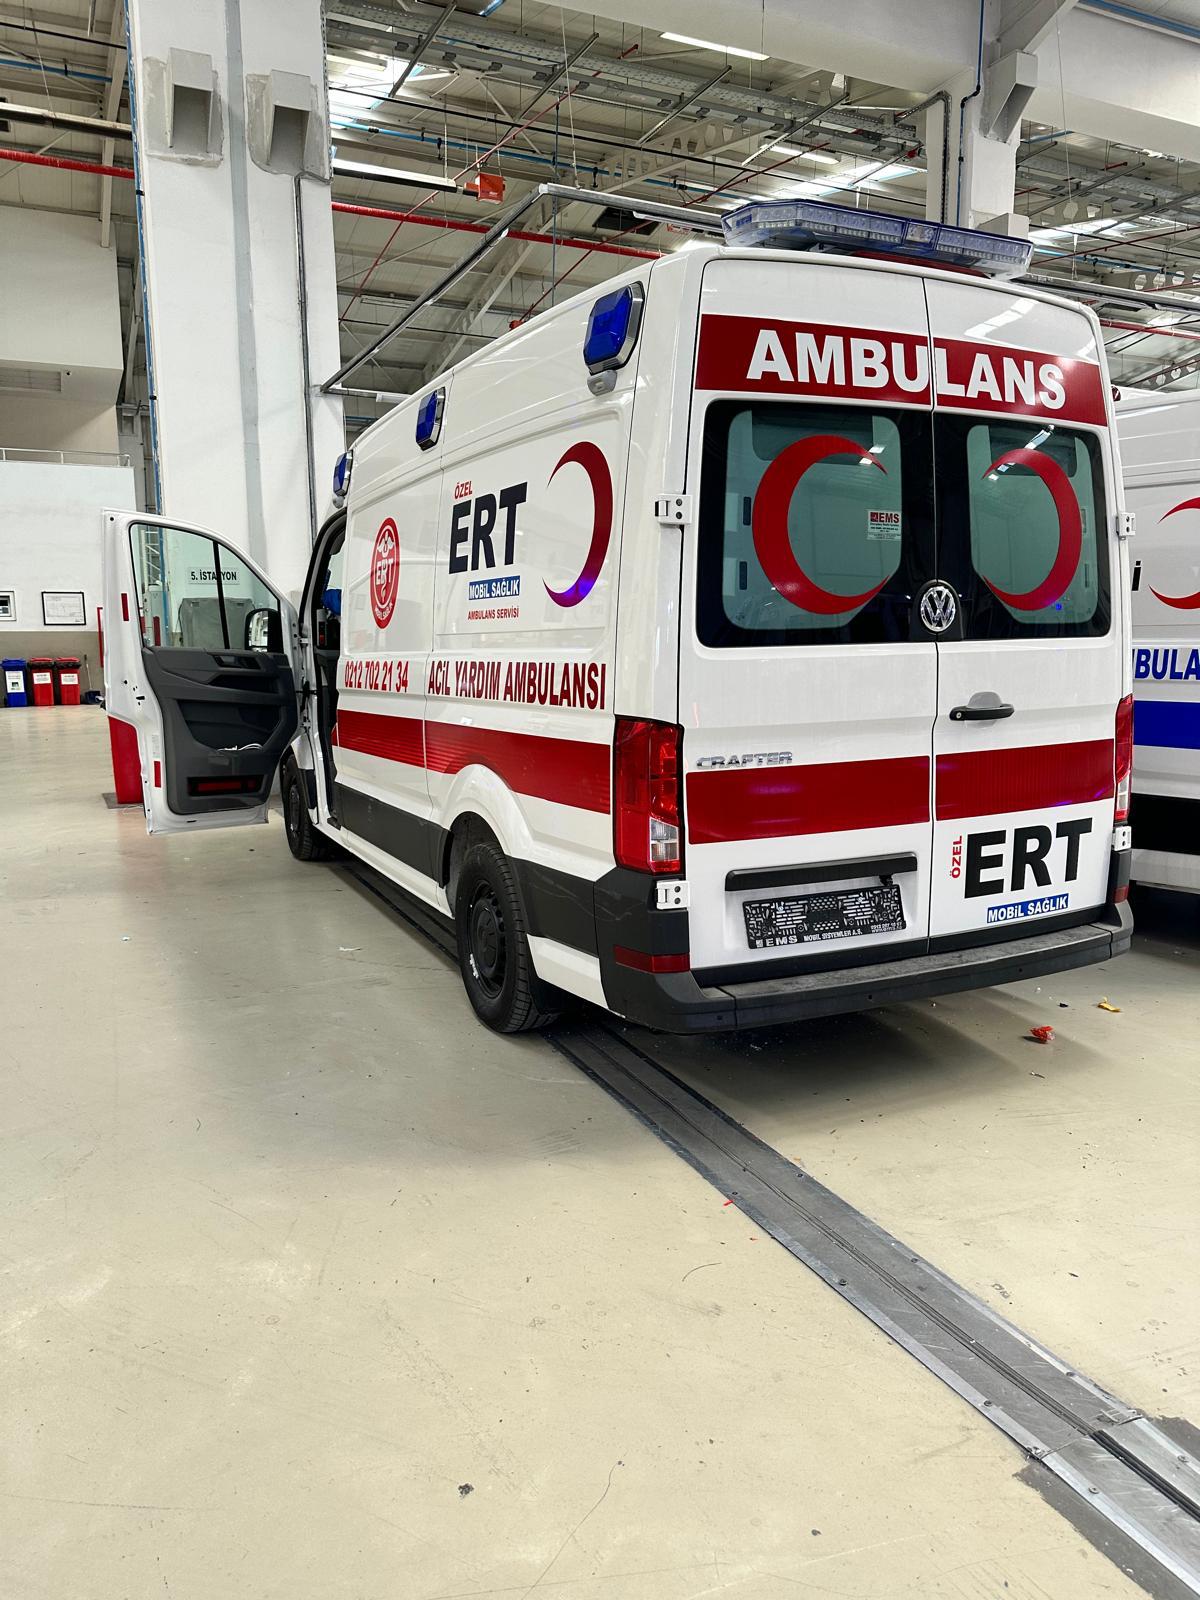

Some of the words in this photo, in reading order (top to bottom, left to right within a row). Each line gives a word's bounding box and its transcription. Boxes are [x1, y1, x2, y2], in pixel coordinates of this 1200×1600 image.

[746, 328, 1066, 410] AMBULANS
[454, 480, 473, 499] ÖZEL
[880, 512, 900, 523] EMS
[449, 481, 527, 574] ERT
[190, 571, 198, 581] 5.
[491, 579, 520, 597] SAĞLIK
[468, 610, 496, 620] AMBULANS
[1132, 648, 1200, 680] BULA
[345, 661, 363, 688] 0212
[364, 661, 380, 690] 702
[381, 661, 394, 691] 21
[395, 661, 409, 693] 34
[455, 661, 501, 700] YARDIM
[503, 662, 606, 710] AMBULANSI
[696, 751, 793, 769] CRAFTER
[949, 835, 963, 879] ÖZEL
[964, 817, 1093, 899] ERT
[1027, 896, 1068, 914] SAĞLIK
[766, 935, 798, 947] EMS
